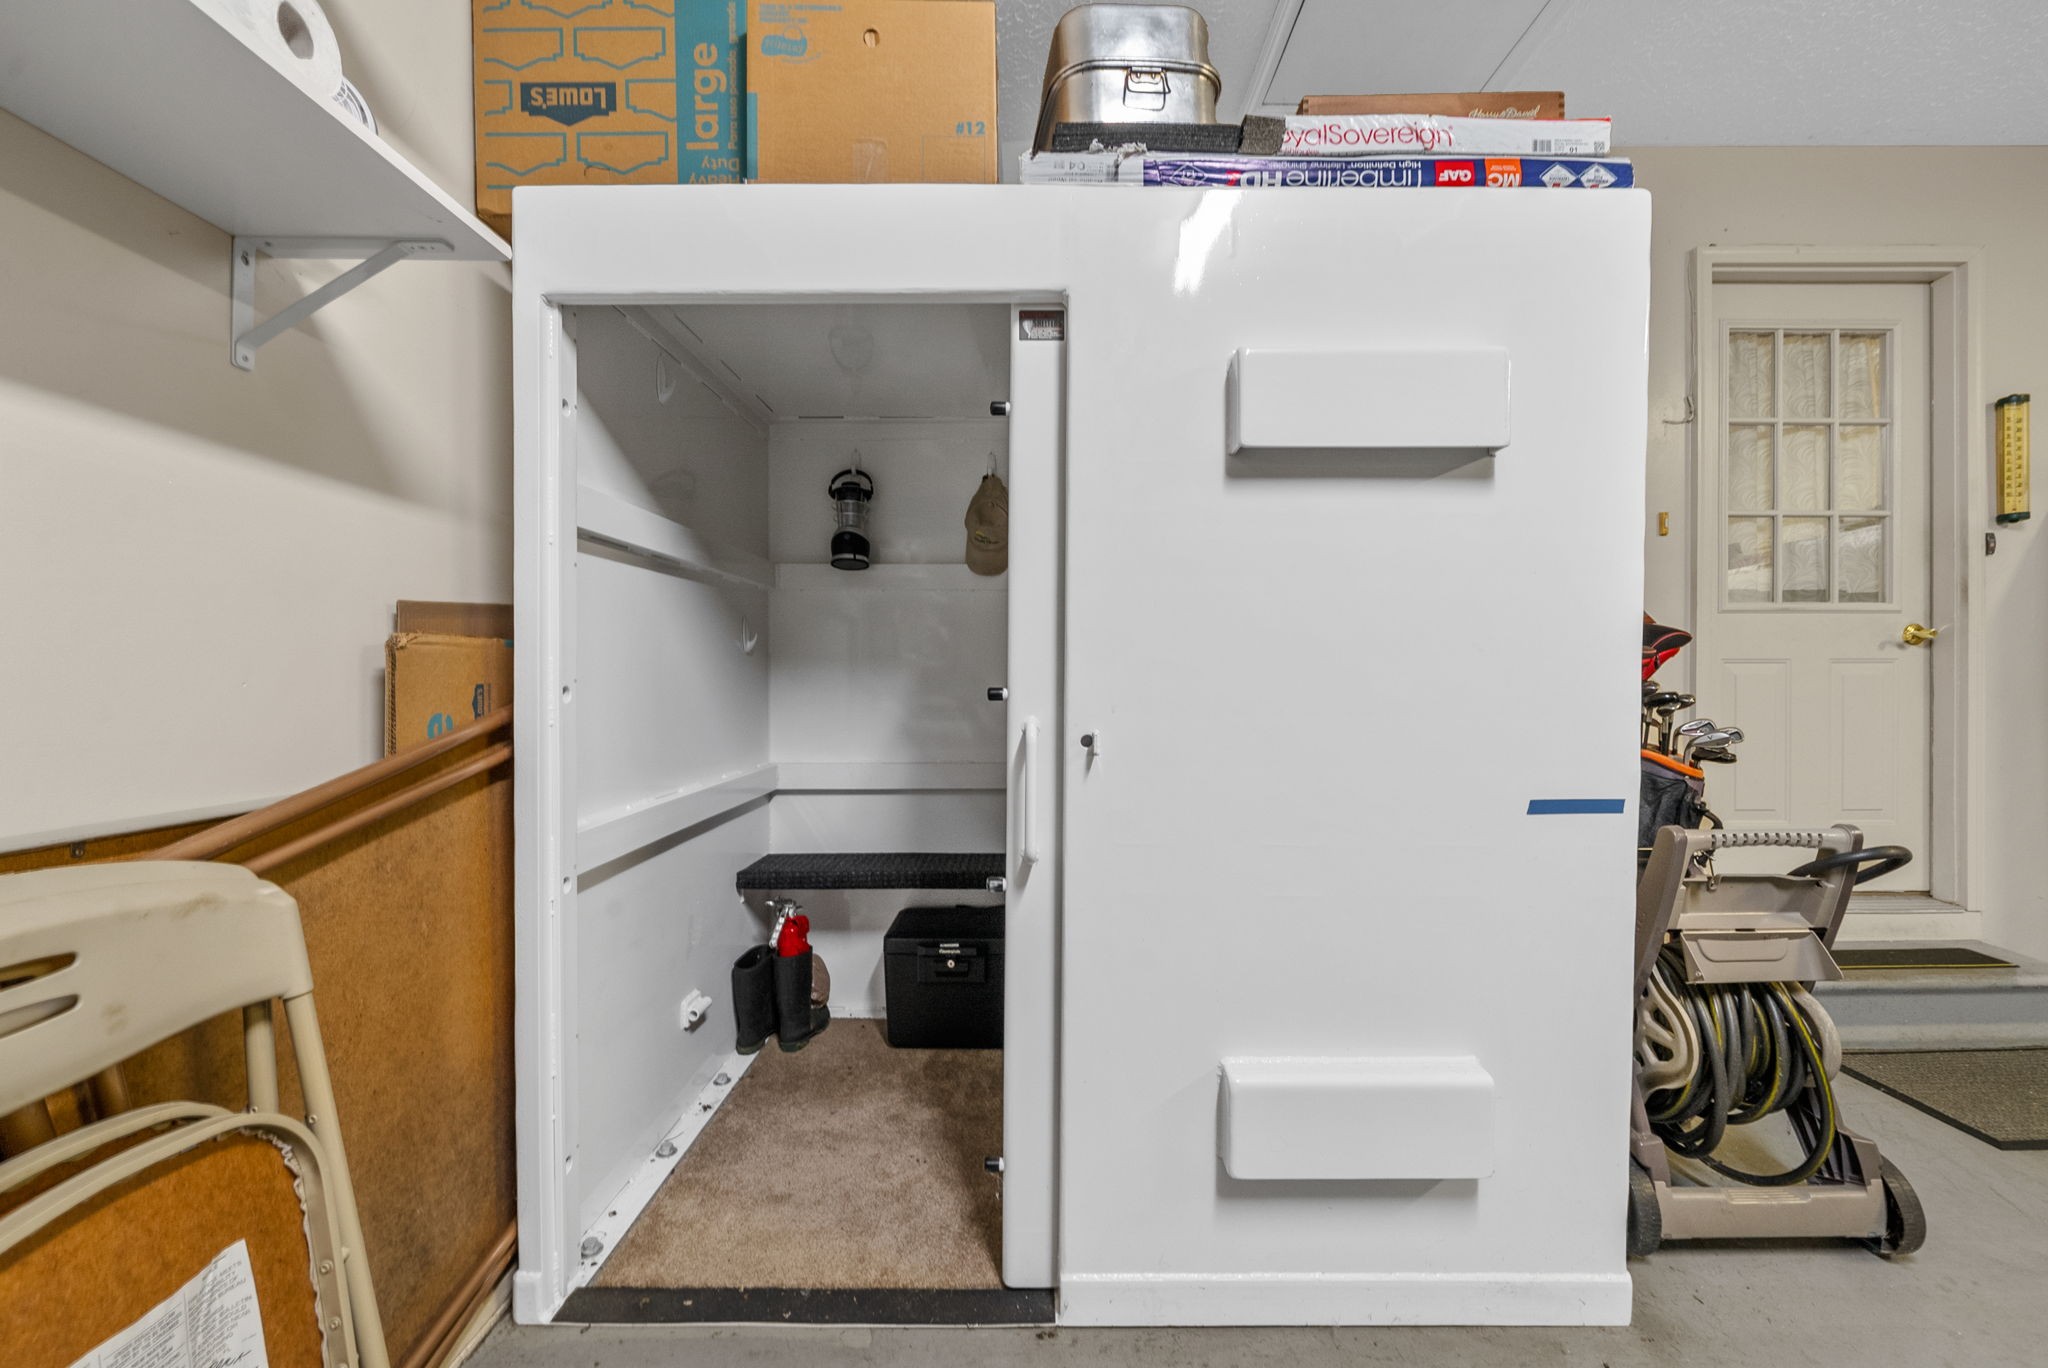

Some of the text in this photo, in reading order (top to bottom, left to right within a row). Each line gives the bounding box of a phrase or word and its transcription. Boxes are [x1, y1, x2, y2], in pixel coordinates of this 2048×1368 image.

[530, 86, 607, 109] LOWE'S
[686, 43, 727, 150] large
[955, 121, 985, 135] #12
[702, 156, 740, 171] Duty
[1350, 160, 1396, 169] Definition
[1398, 160, 1422, 169] High
[1286, 168, 1422, 188] Timberline
[1438, 169, 1472, 182] GAF
[1488, 172, 1520, 187] MC
